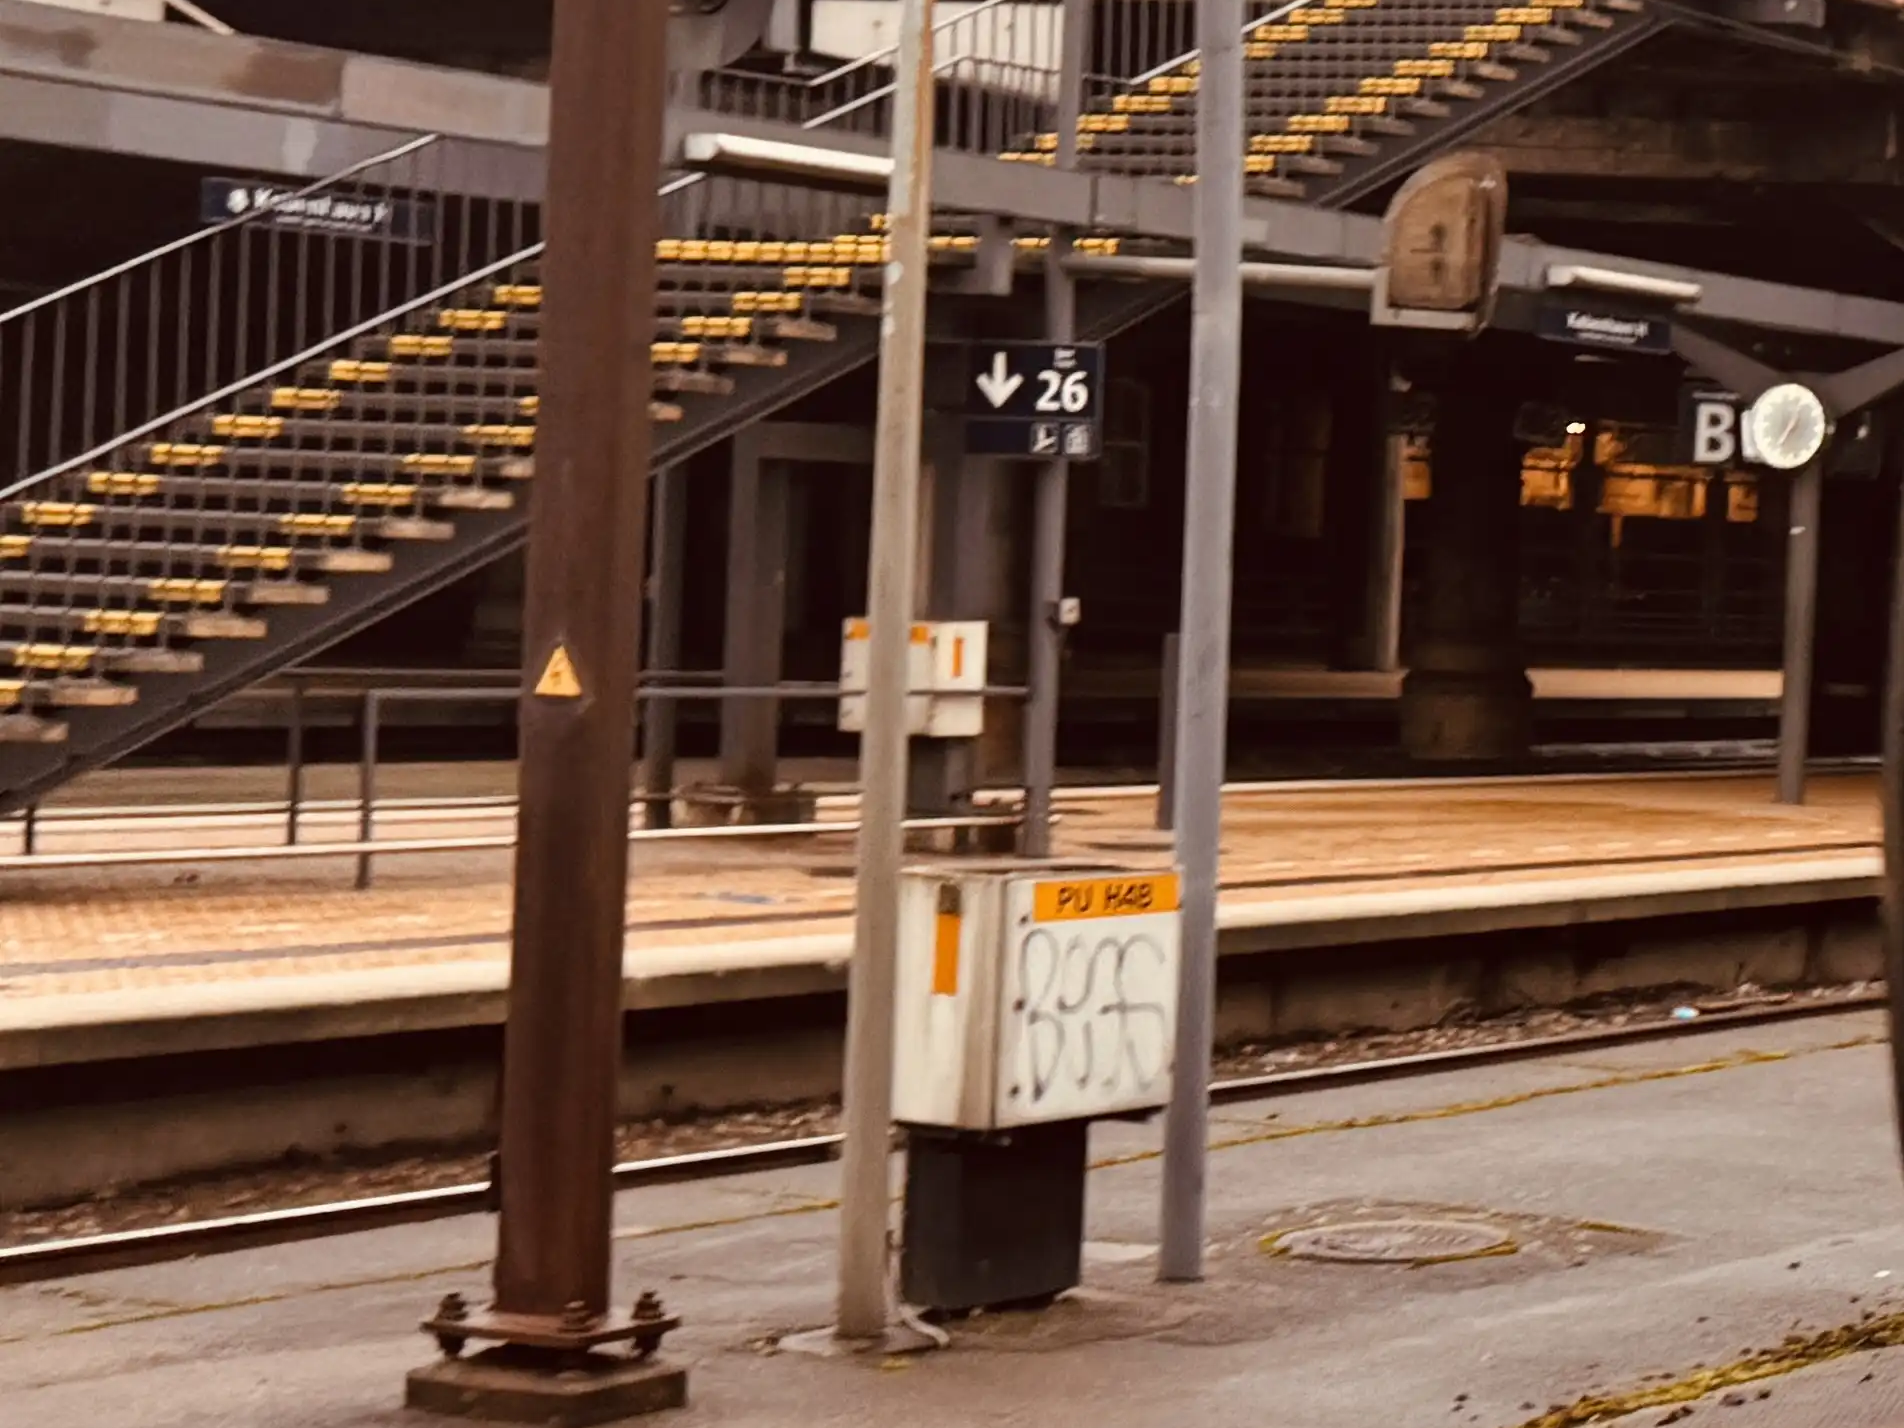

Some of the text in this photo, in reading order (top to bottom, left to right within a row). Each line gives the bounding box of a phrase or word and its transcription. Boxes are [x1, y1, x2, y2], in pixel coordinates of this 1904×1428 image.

[1036, 370, 1089, 412] 26
[1694, 402, 1735, 462] B
[1056, 885, 1094, 915] PU
